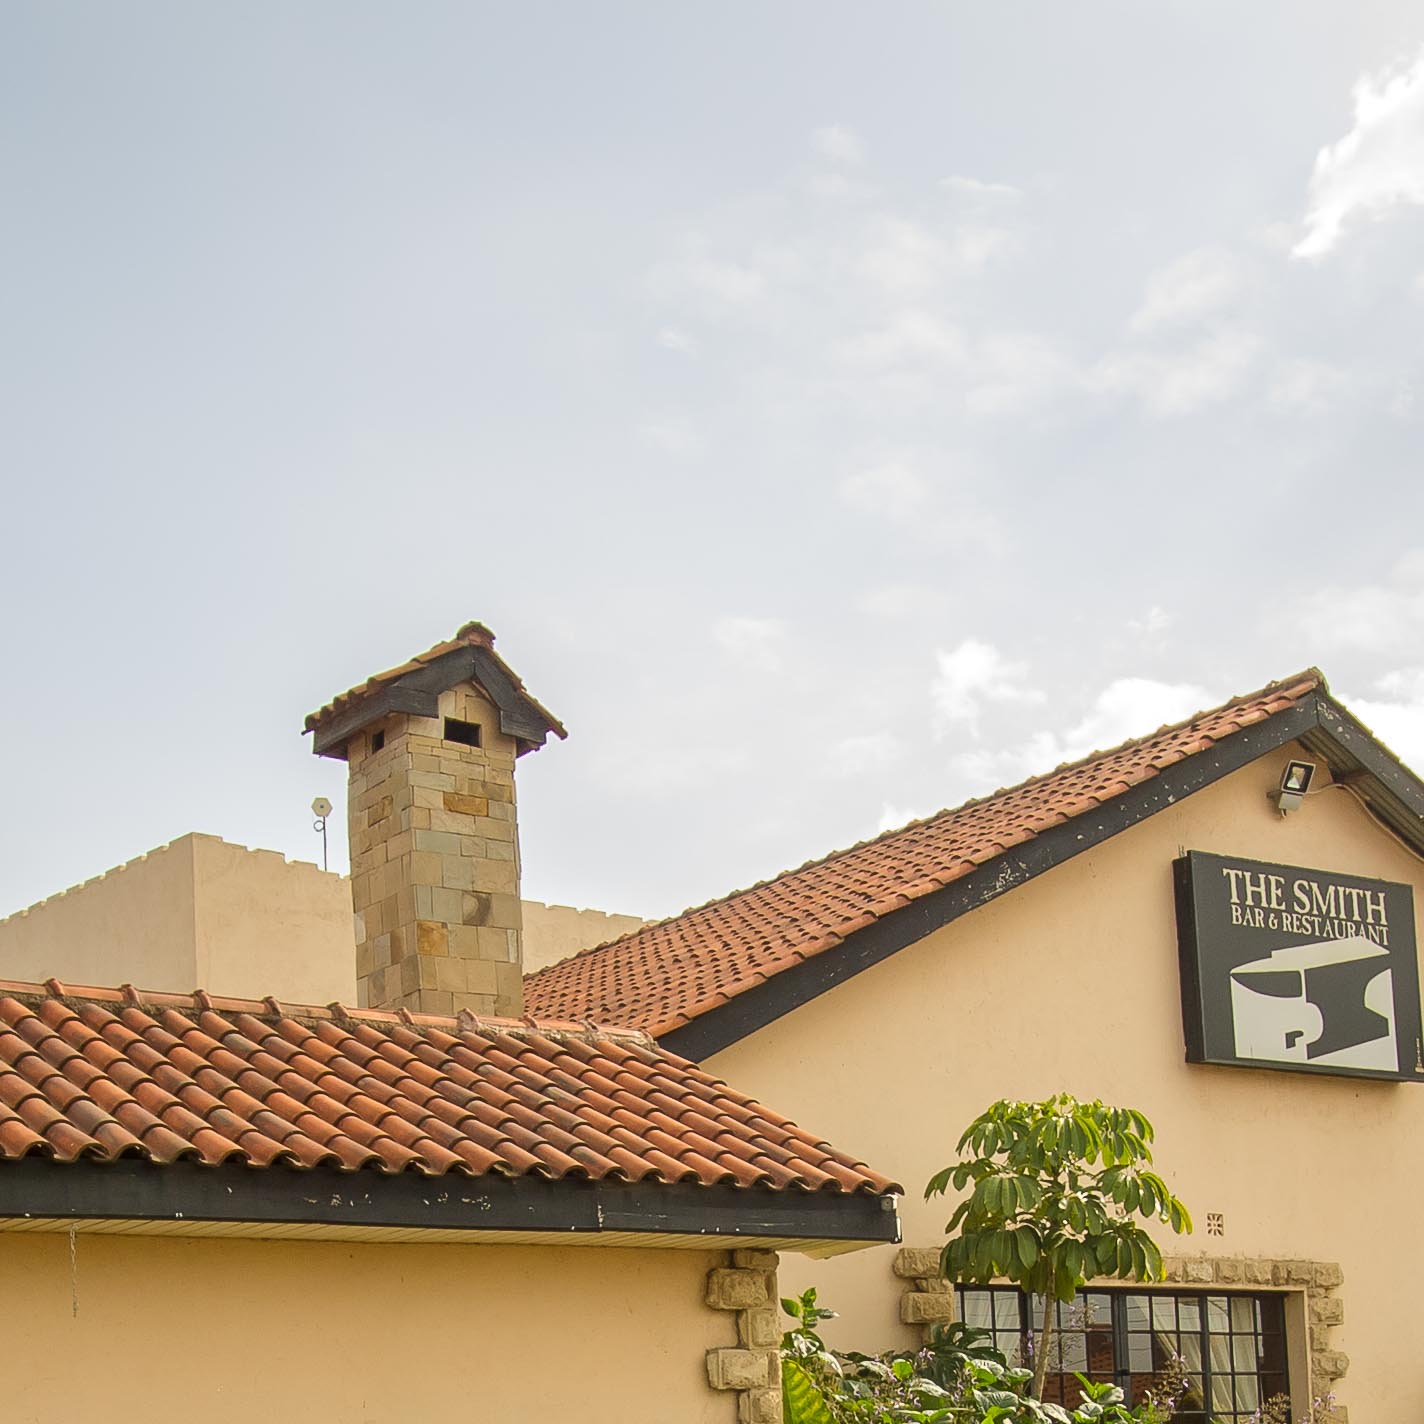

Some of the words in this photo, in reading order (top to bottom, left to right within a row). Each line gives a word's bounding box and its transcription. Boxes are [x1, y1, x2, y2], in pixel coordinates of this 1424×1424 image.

[1223, 868, 1286, 911] THE
[1293, 879, 1388, 925] SMITH
[1231, 904, 1265, 928] BAR
[1268, 913, 1278, 930] &
[1282, 914, 1389, 945] RESTAURANT
